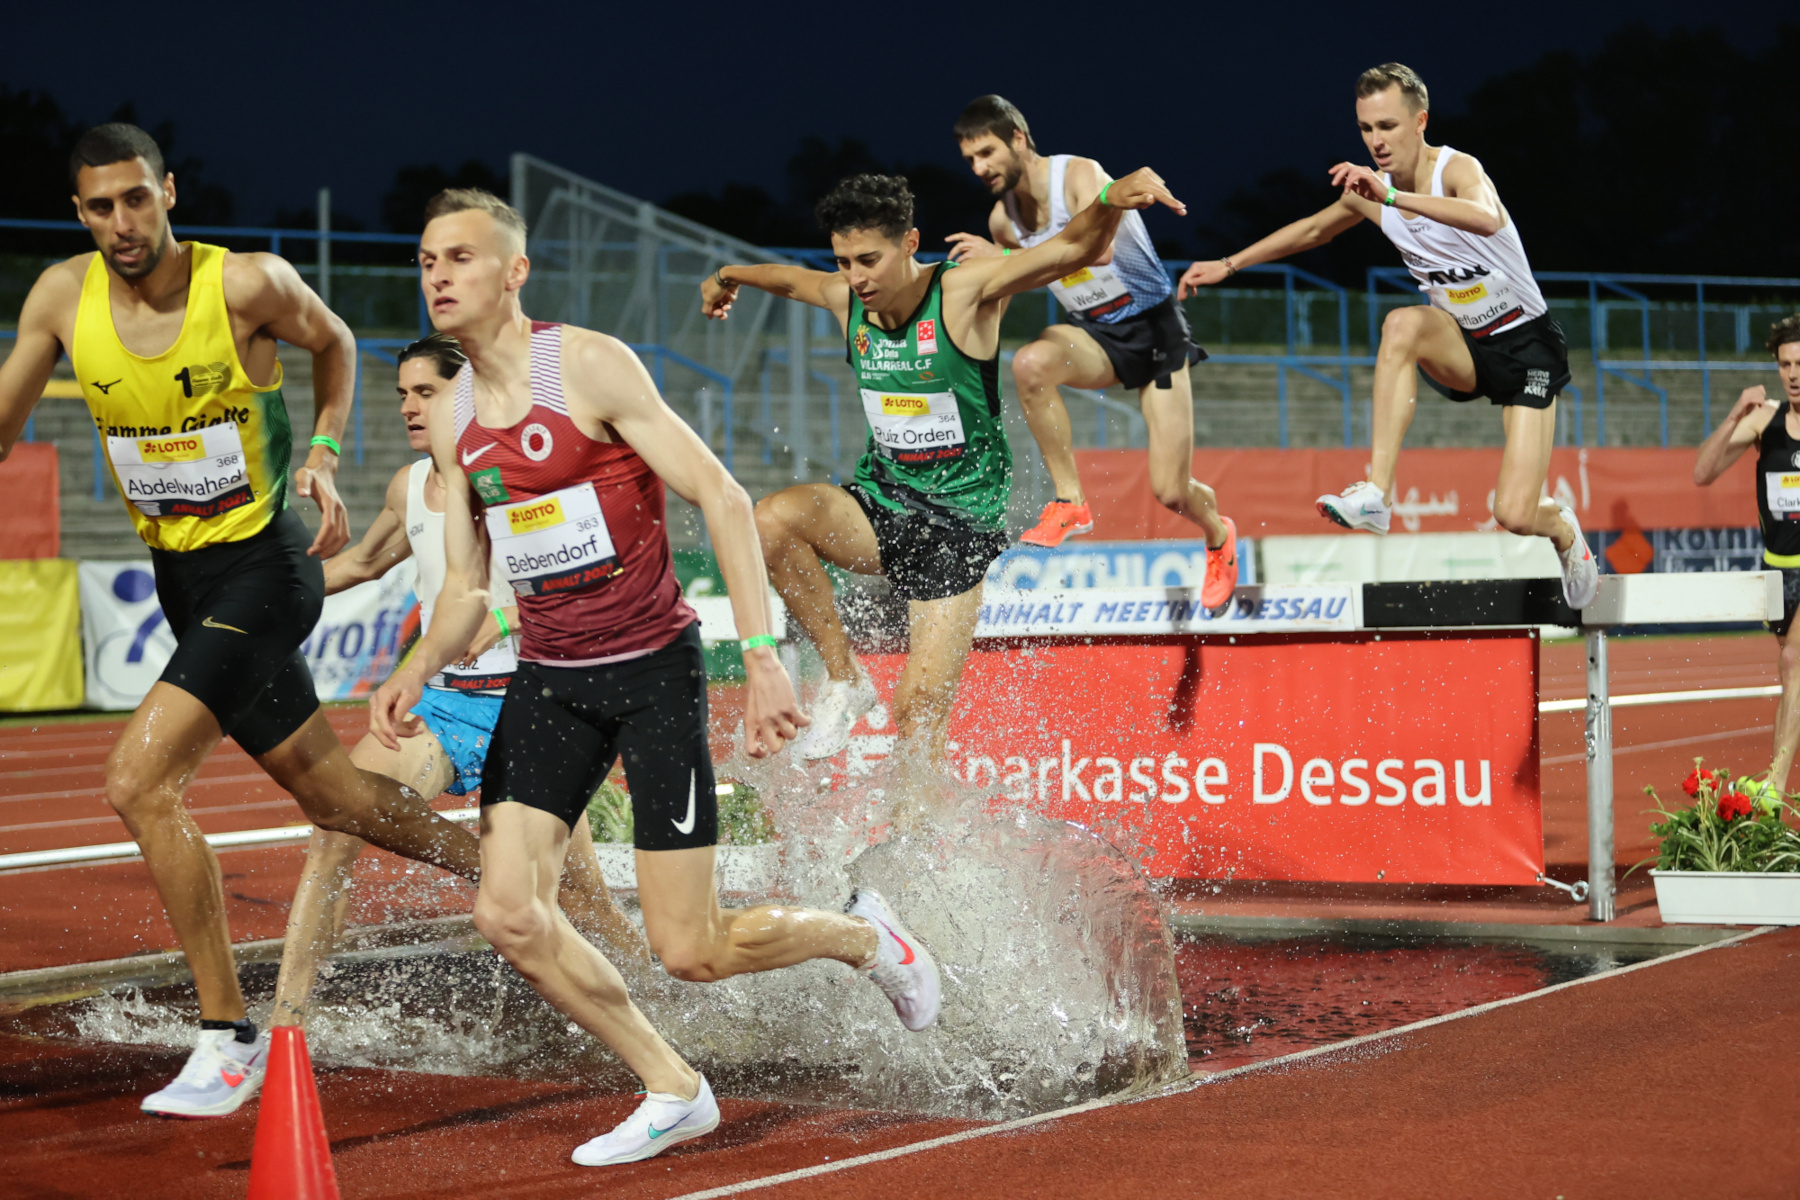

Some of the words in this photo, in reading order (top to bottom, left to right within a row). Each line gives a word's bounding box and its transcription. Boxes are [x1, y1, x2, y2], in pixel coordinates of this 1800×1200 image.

[1072, 288, 1108, 306] Wedel
[1455, 287, 1481, 299] LOTTO
[860, 359, 914, 371] VILLARREAL
[895, 399, 923, 408] LOTTO
[938, 415, 956, 423] 364
[903, 428, 956, 444] Orden
[158, 440, 197, 453] LOTTO
[898, 451, 935, 462] ANHALT
[936, 447, 962, 459] 2021
[216, 455, 239, 467] 368
[129, 469, 242, 495] Abdelwahed
[171, 503, 214, 515] ANHALT
[217, 491, 247, 511] 2021
[520, 503, 555, 521] LOTTO
[576, 517, 599, 532] 363
[506, 534, 598, 574] Bebendorf
[541, 573, 582, 592] ANHALT
[583, 563, 614, 583] 2021
[978, 601, 1084, 625] ANHALT
[1231, 596, 1347, 620] DESSAU
[950, 738, 1229, 806] parkasse
[1253, 742, 1492, 806] Dessau
